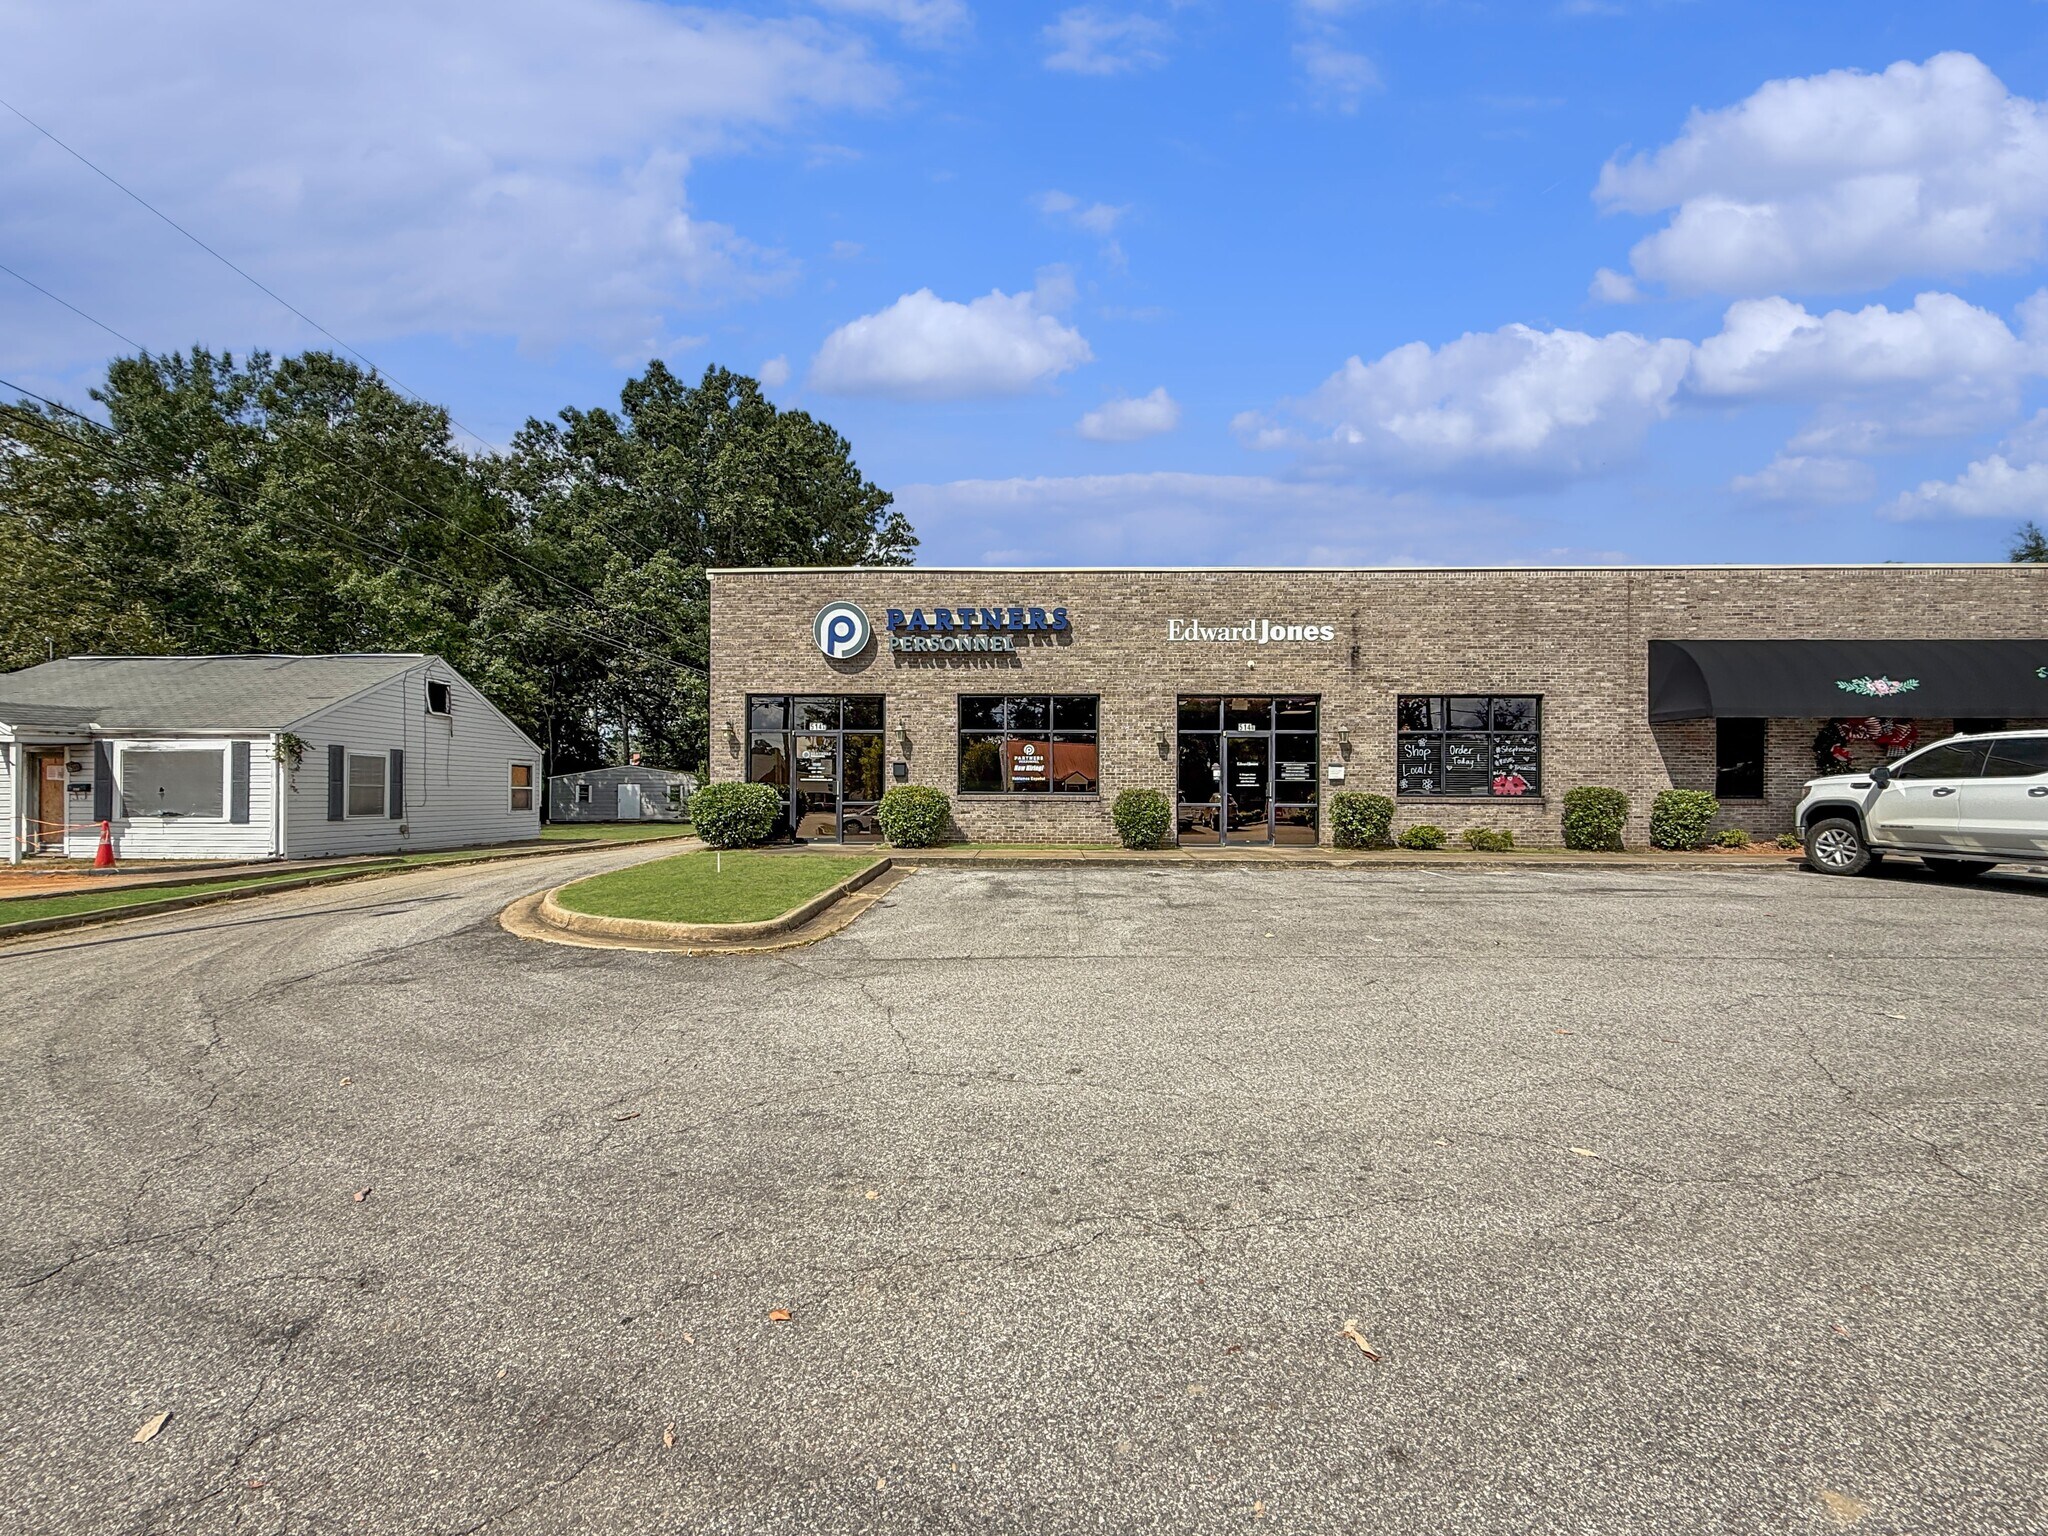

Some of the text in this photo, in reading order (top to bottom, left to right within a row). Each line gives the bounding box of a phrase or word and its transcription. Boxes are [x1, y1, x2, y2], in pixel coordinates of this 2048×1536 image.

[886, 607, 1068, 631] PARTNERS
[889, 636, 1016, 652] PERSONNEL
[1404, 744, 1431, 760] Shop
[1449, 745, 1474, 755] Order
